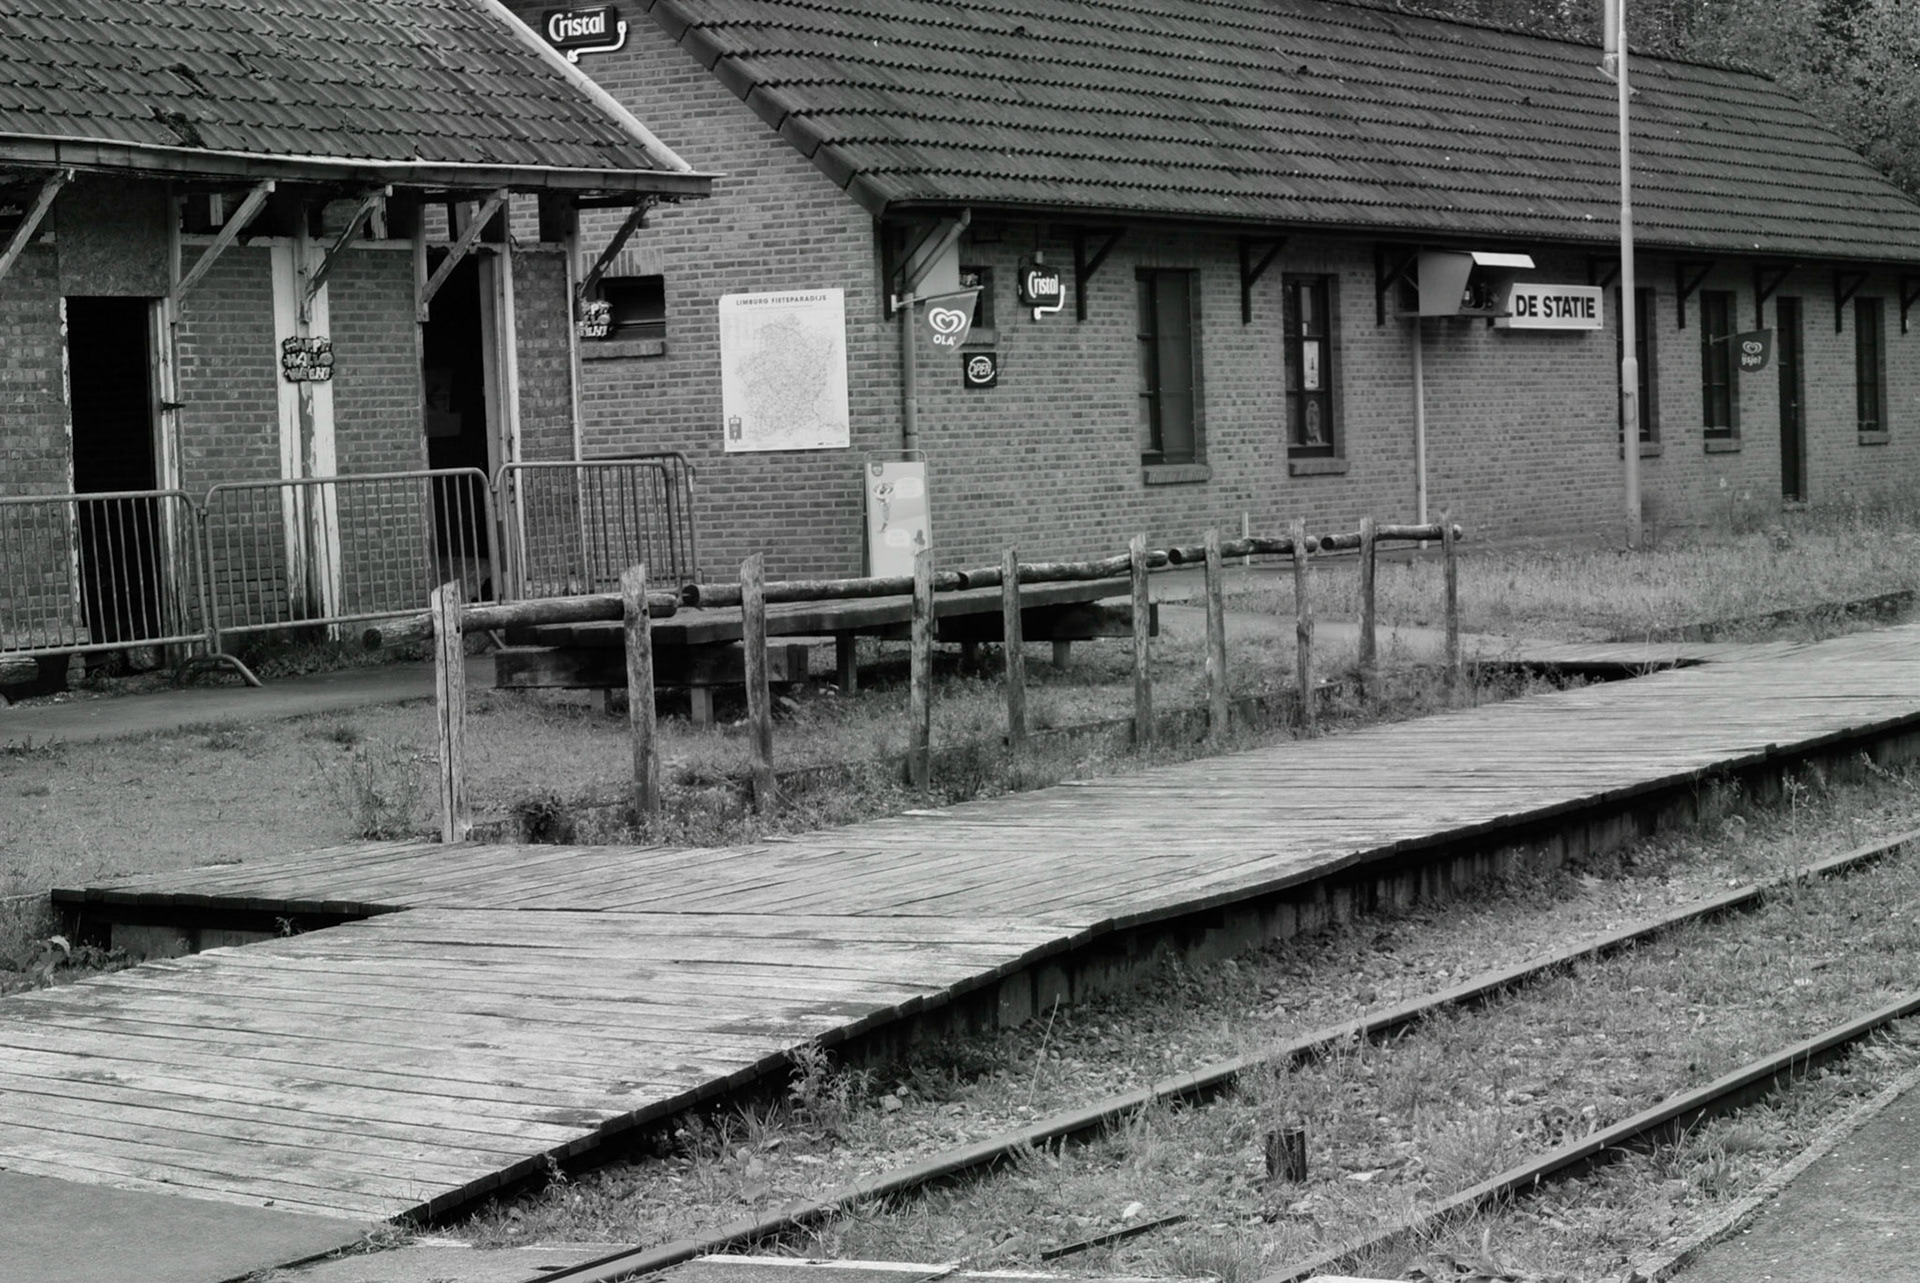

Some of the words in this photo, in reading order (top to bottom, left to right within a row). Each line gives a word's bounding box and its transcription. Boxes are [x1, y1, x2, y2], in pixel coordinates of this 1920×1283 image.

[548, 11, 606, 42] Cristal
[1027, 270, 1059, 299] Cristal
[736, 298, 769, 306] LIMBURG
[771, 294, 827, 304] FIETSPARADIJS
[1516, 295, 1538, 317] DE
[1543, 296, 1596, 319] STATIE
[968, 362, 992, 376] OPEN
